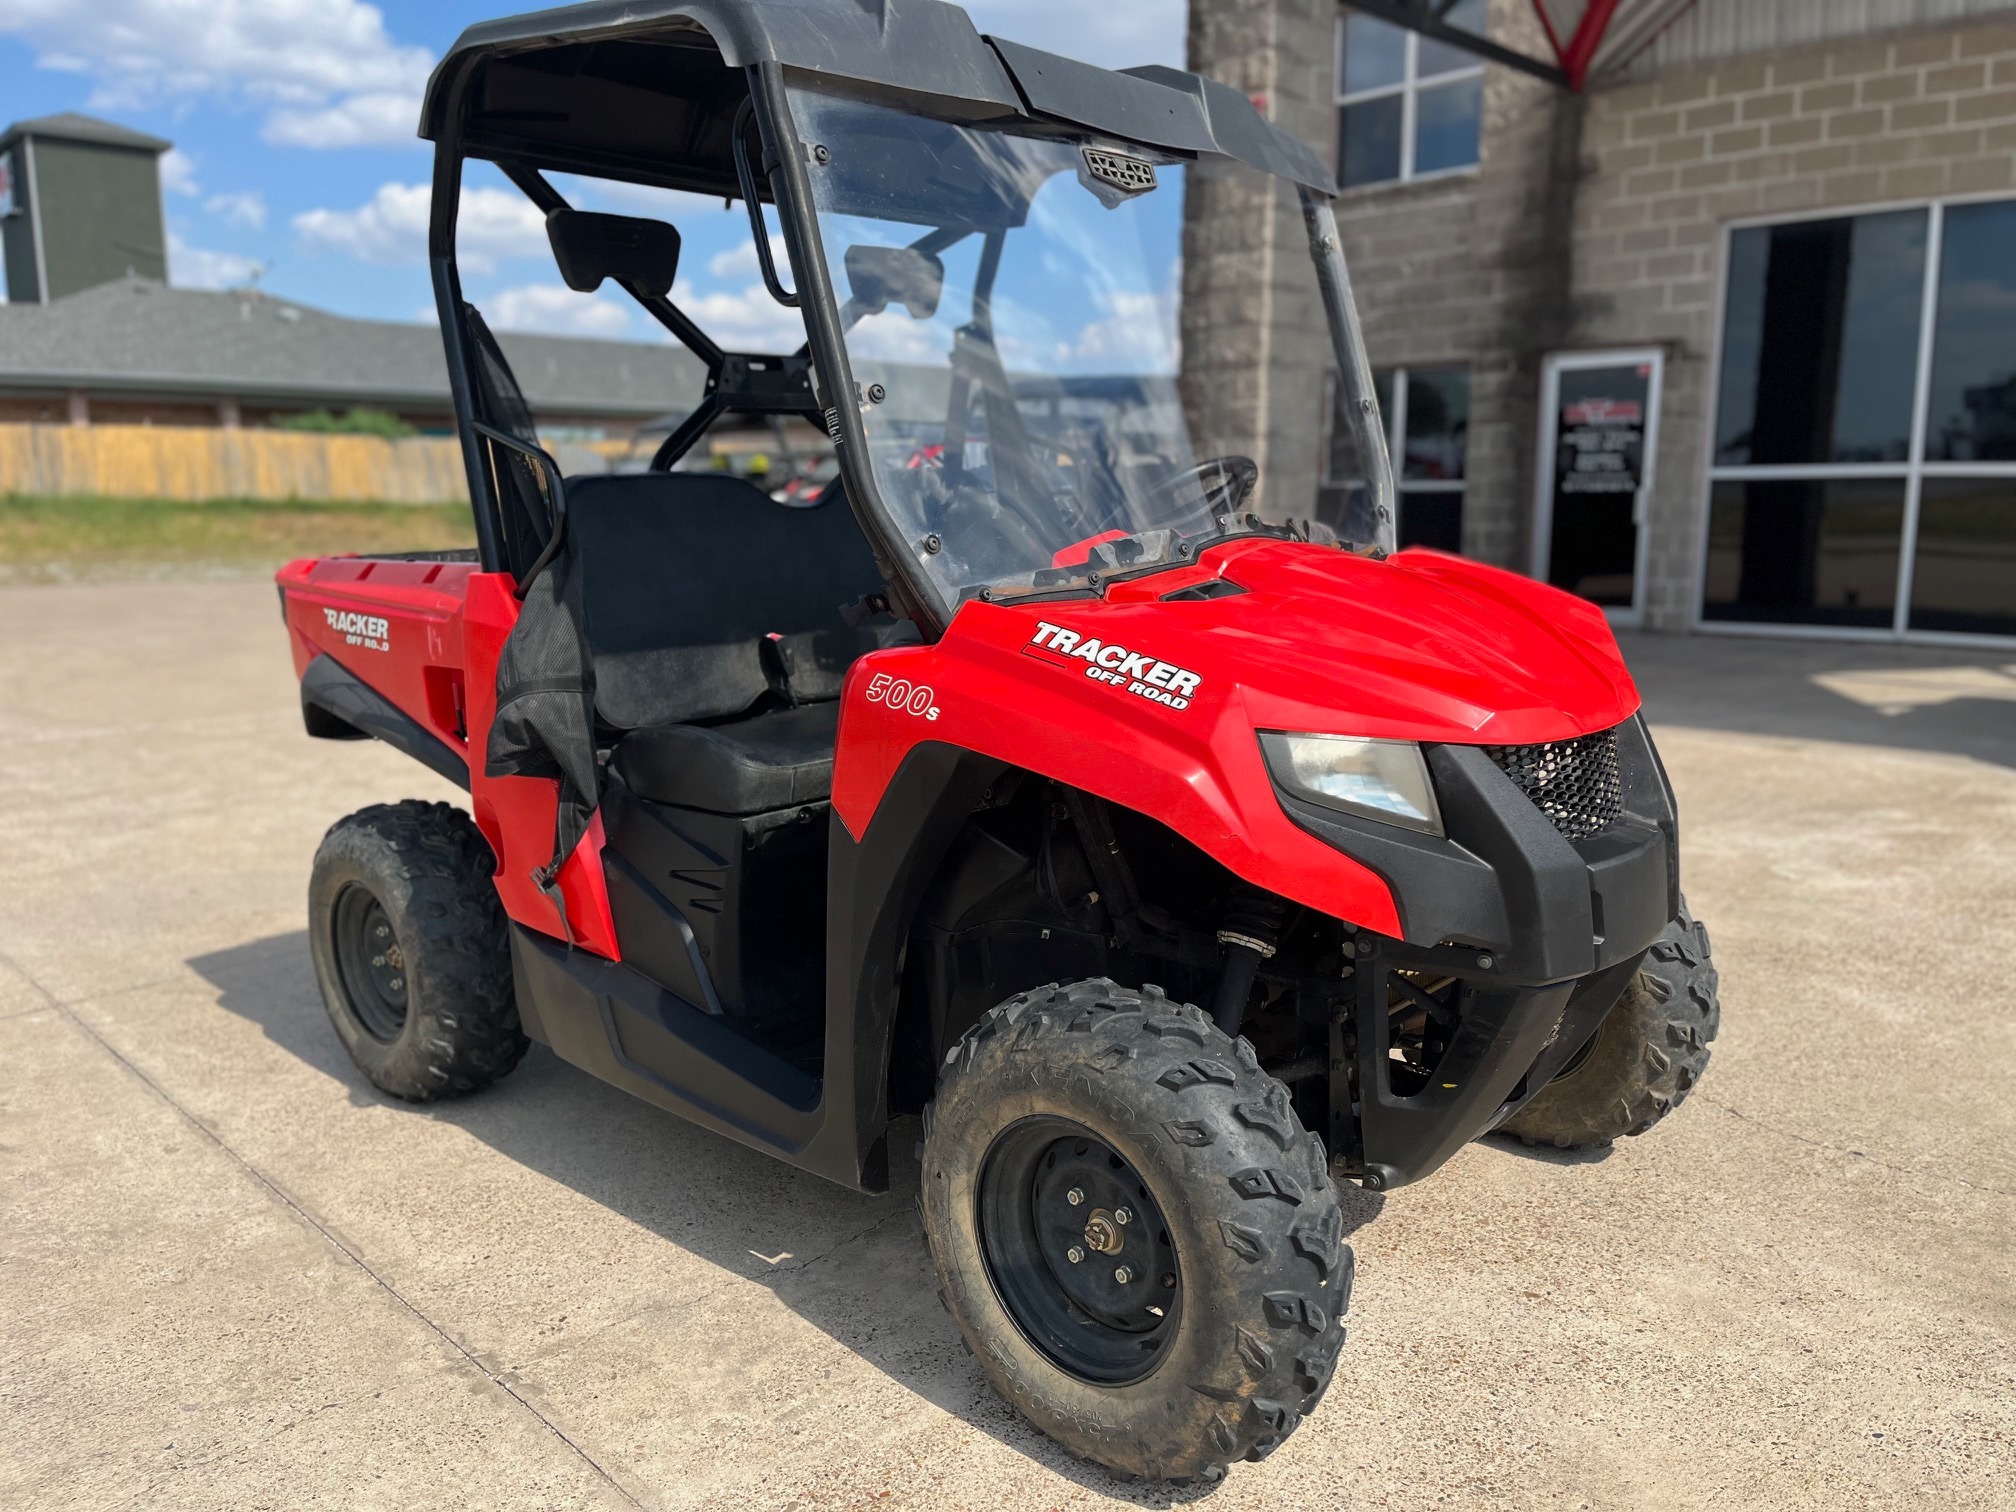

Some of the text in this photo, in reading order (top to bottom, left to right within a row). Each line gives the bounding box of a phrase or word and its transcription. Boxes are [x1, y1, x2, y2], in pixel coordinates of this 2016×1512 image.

[346, 634, 389, 652] OFF ROD
[1031, 620, 1202, 698] TRACKER
[1085, 666, 1189, 711] OFF ROAD
